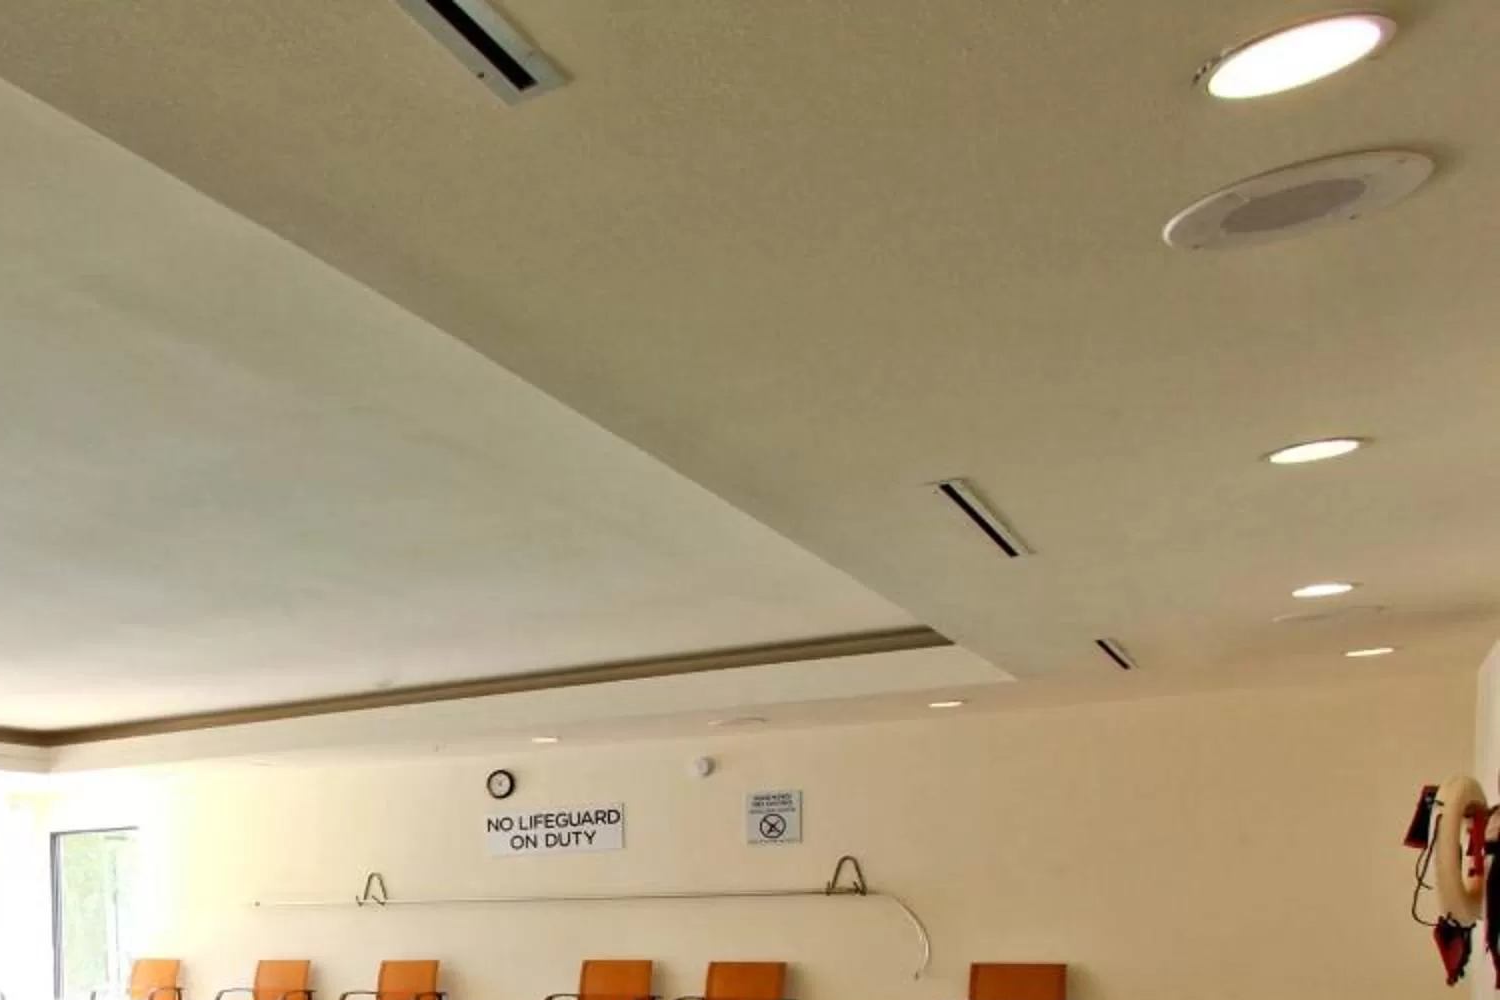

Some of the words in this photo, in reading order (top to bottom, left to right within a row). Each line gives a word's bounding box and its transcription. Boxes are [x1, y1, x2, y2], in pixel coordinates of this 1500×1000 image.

[487, 816, 514, 832] NO
[518, 809, 621, 831] LIFEGUARD
[510, 834, 538, 850] ON
[545, 830, 596, 848] DUTY
